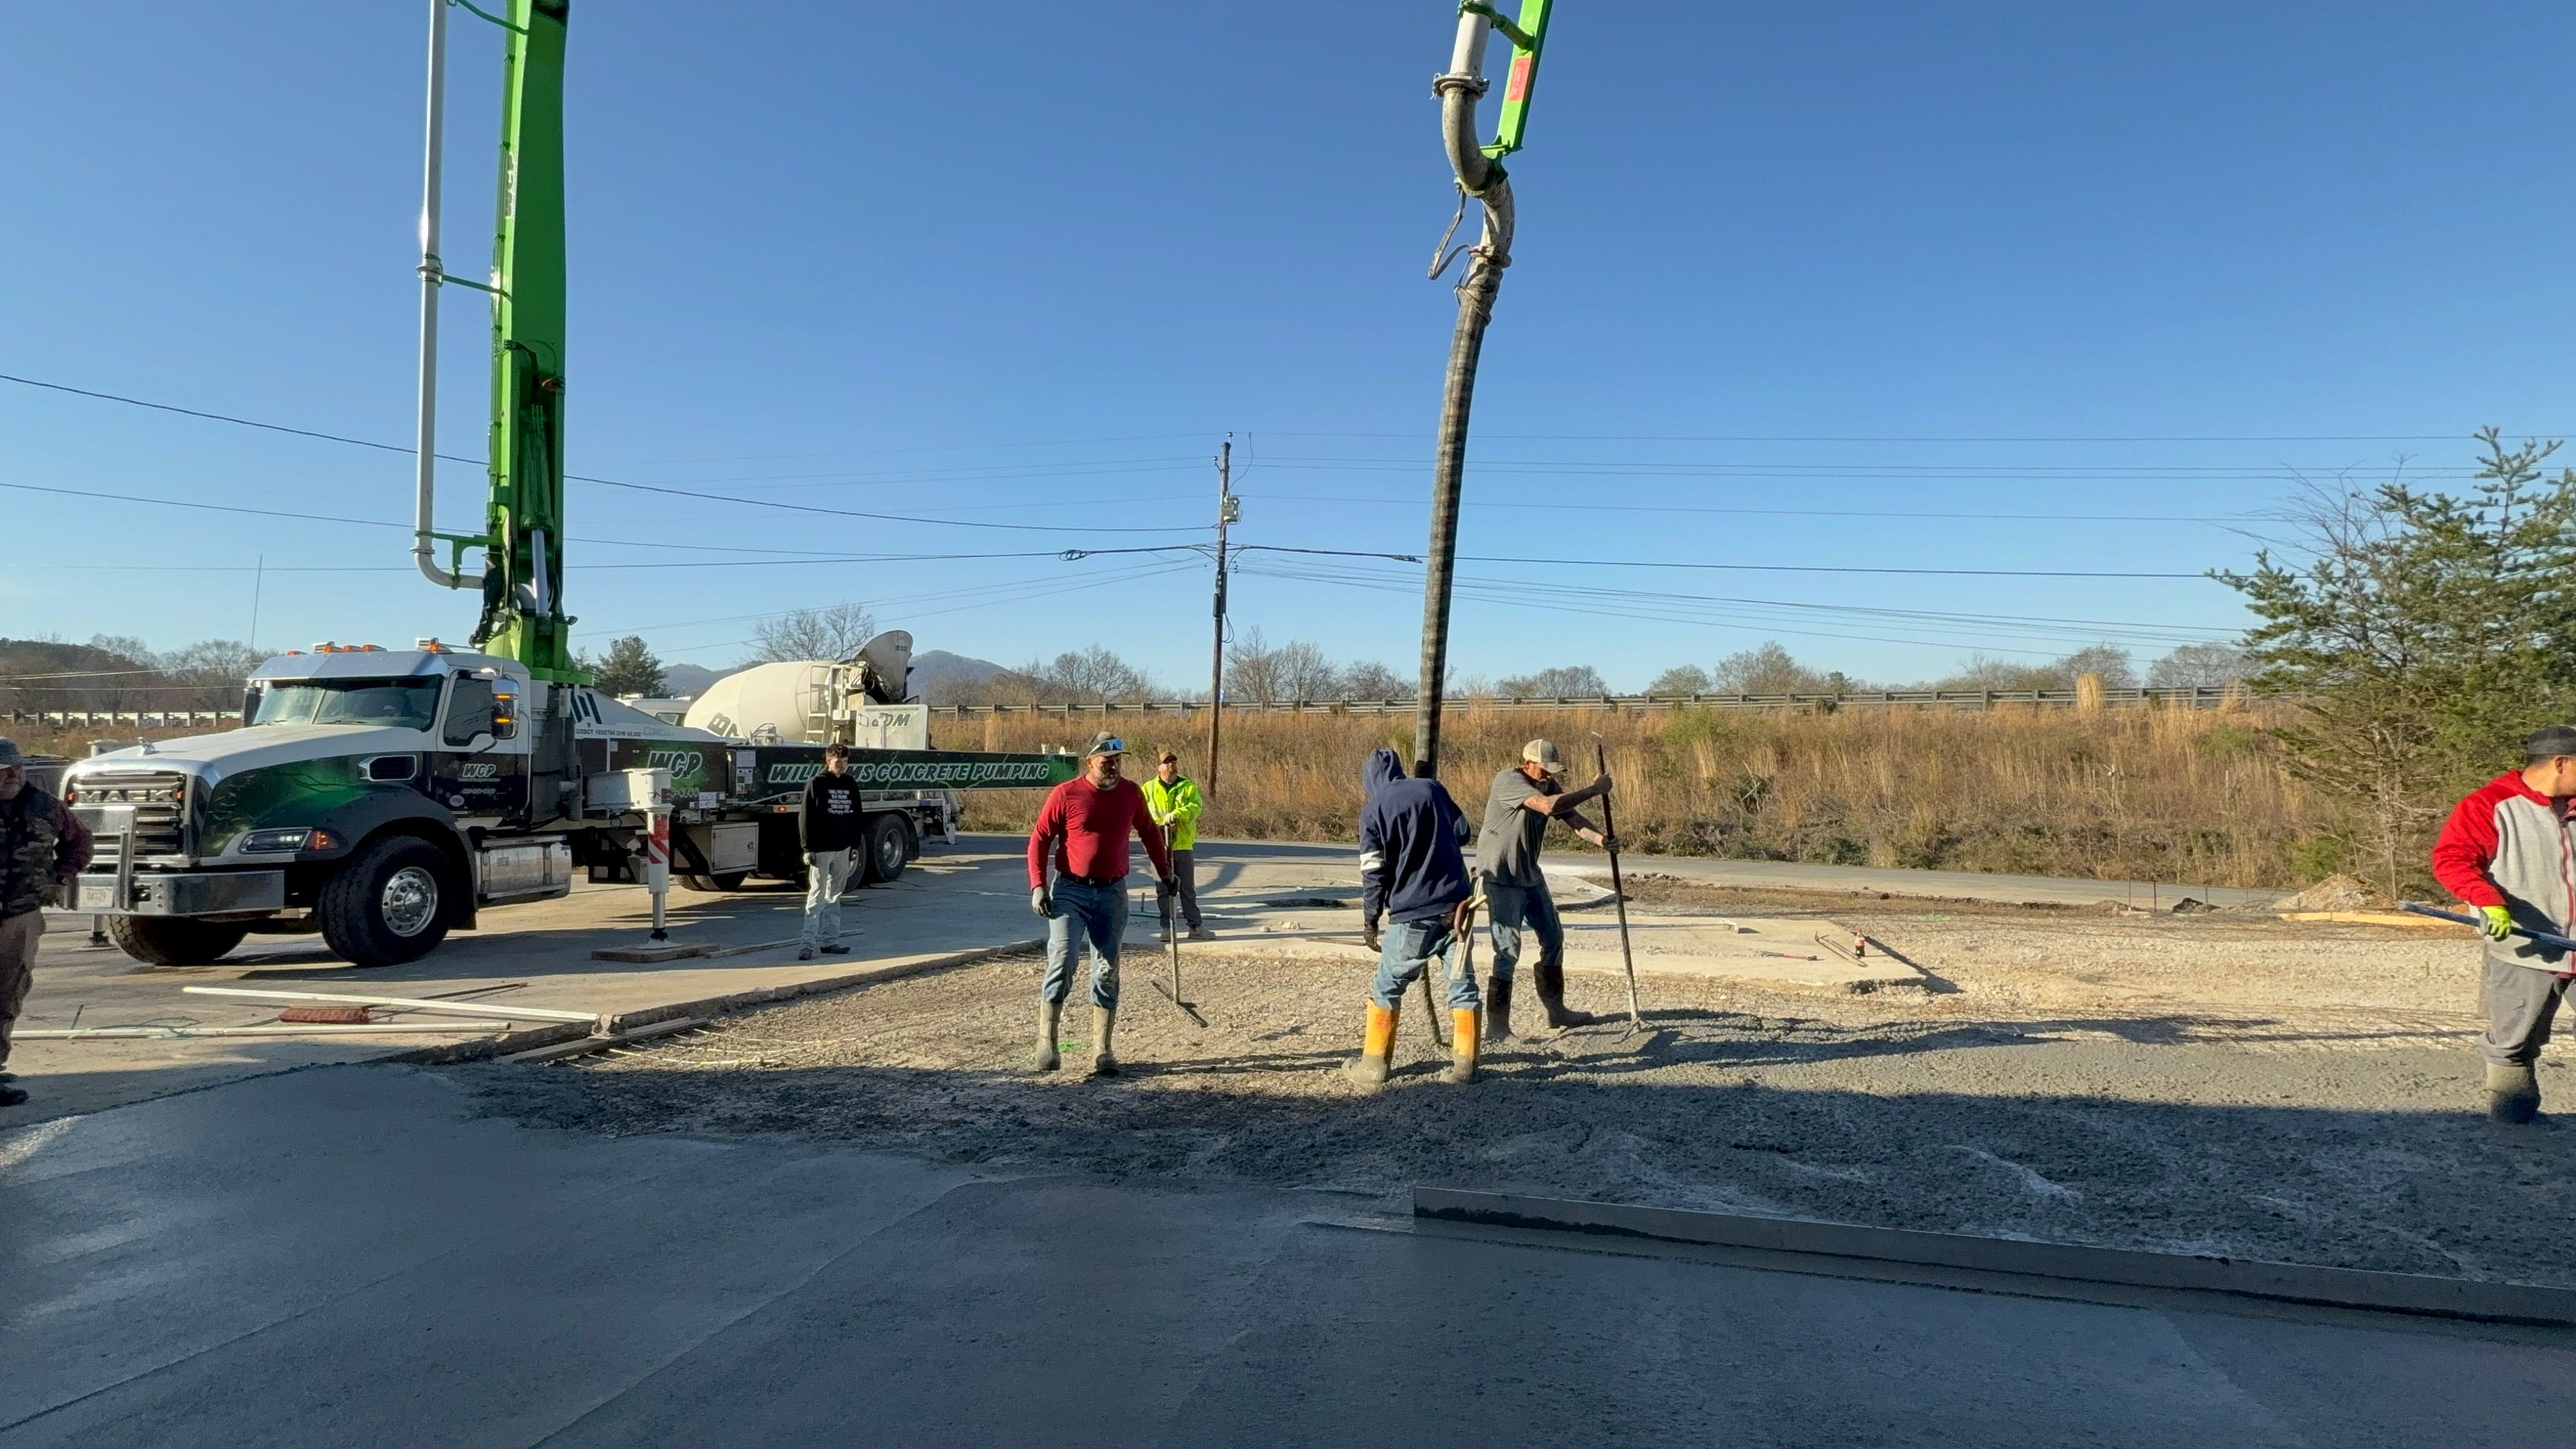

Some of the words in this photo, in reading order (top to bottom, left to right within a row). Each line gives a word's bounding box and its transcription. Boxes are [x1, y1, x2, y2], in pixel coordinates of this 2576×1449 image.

[463, 763, 496, 777] WCP
[647, 751, 703, 779] WCP
[768, 763, 876, 782] WILLMS
[876, 763, 973, 782] CONCRETE
[970, 763, 1049, 780] PUMPING
[78, 790, 172, 801] MACK
